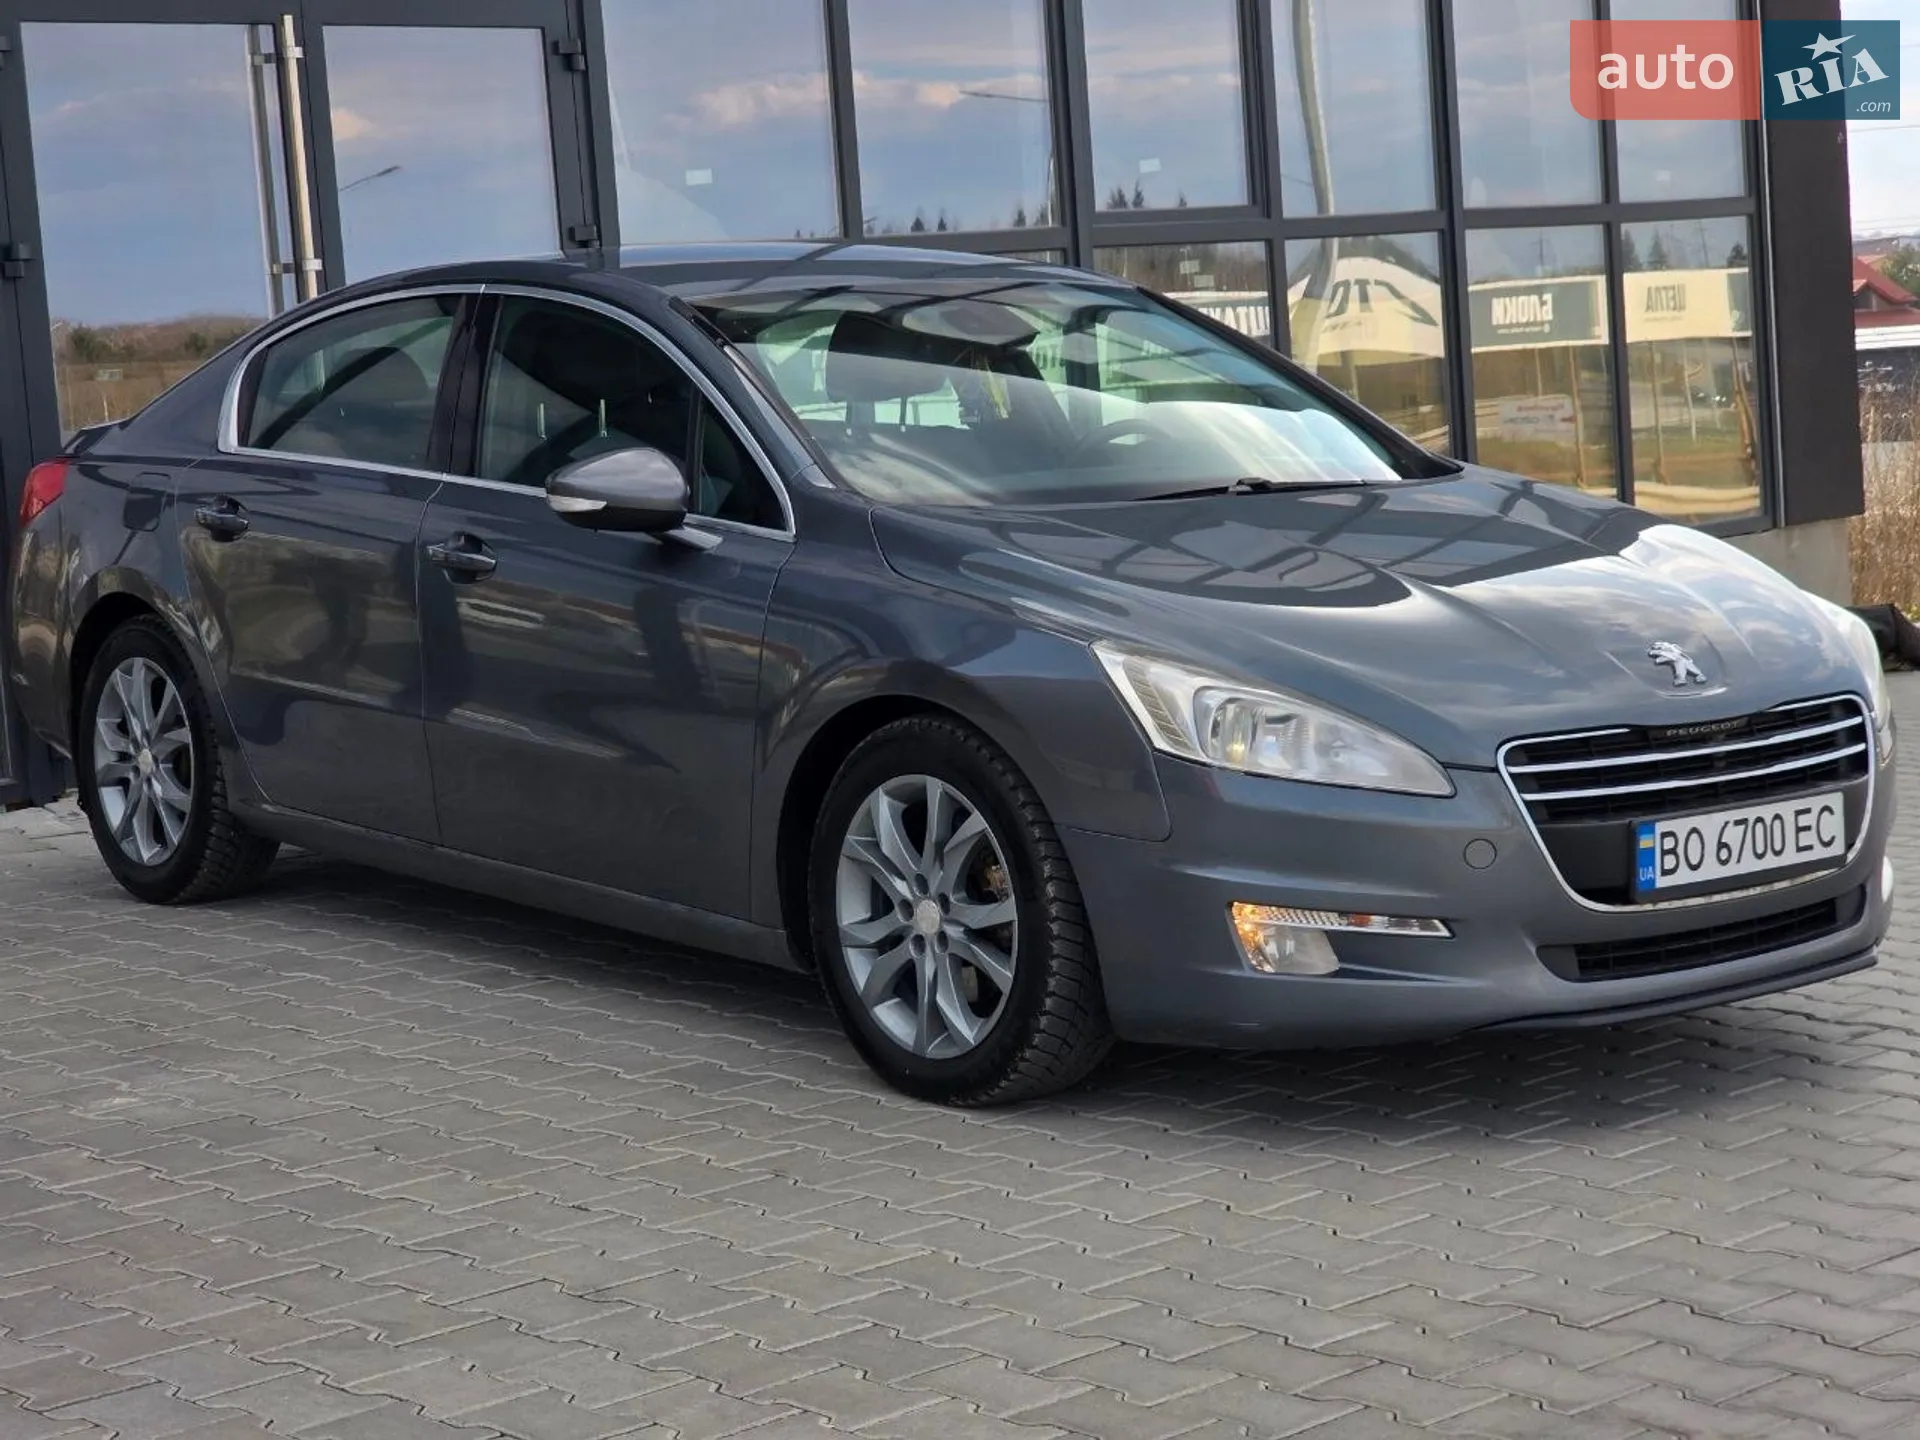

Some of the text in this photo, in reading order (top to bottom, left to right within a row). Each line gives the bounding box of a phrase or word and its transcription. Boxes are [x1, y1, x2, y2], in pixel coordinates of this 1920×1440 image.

[1666, 721, 1738, 737] PEUGEOT
[1660, 804, 1836, 877] BO 6700 EC
[1639, 868, 1655, 881] UA
